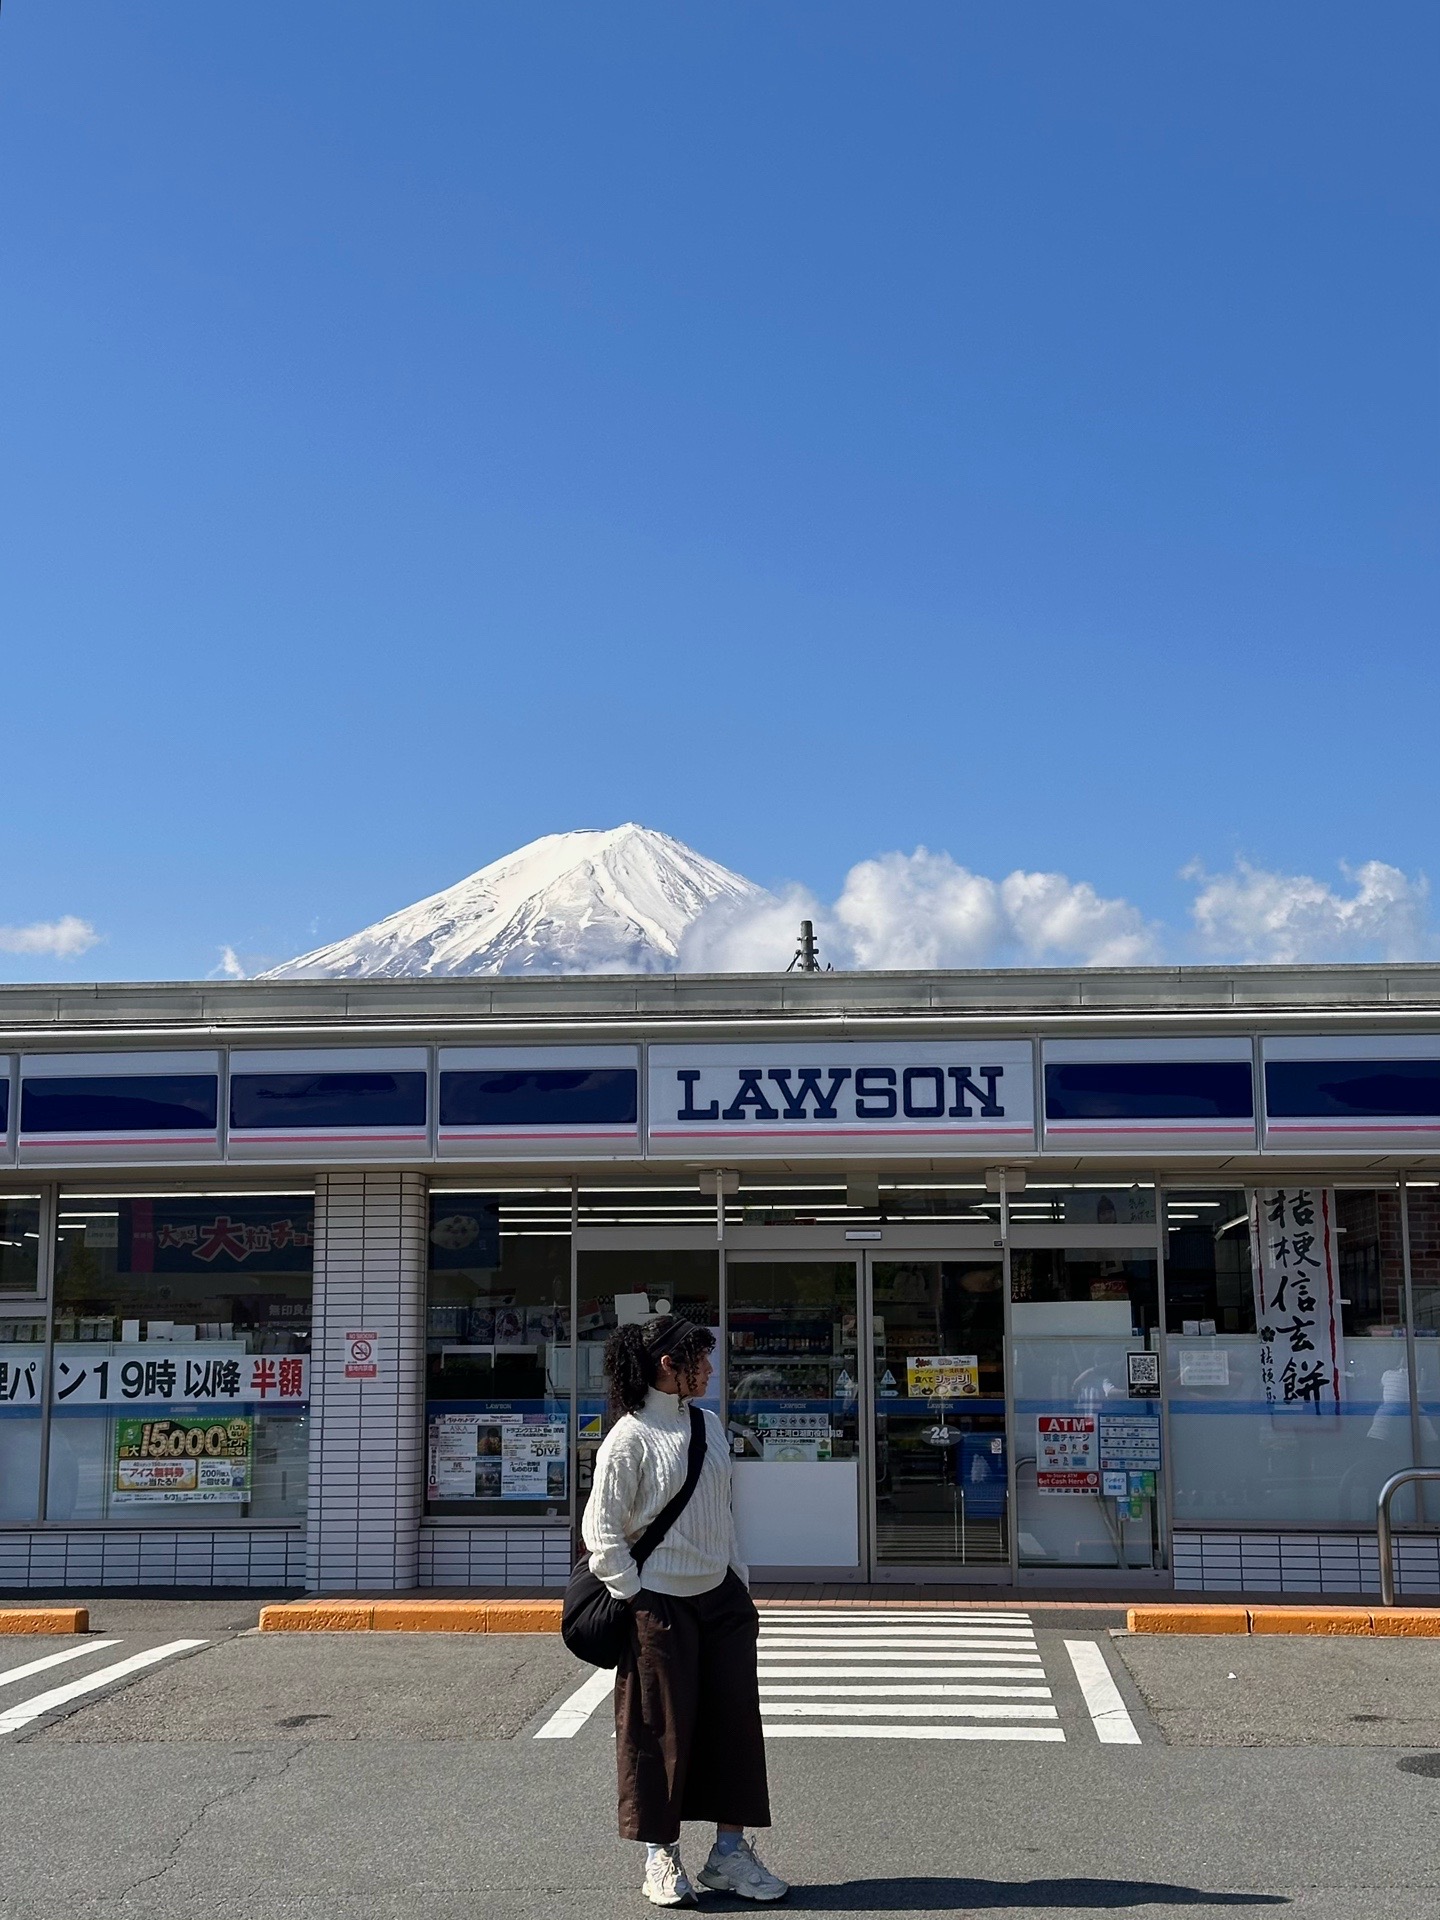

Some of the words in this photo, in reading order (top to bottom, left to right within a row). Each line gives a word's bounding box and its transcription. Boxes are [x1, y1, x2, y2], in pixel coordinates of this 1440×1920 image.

[677, 1067, 1004, 1120] LAWSON
[1048, 1419, 1086, 1431] ATM
[931, 1426, 949, 1439] 24
[120, 1445, 139, 1456] 最大
[536, 1448, 561, 1456] DIVE
[130, 1467, 184, 1477] アイス無料券
